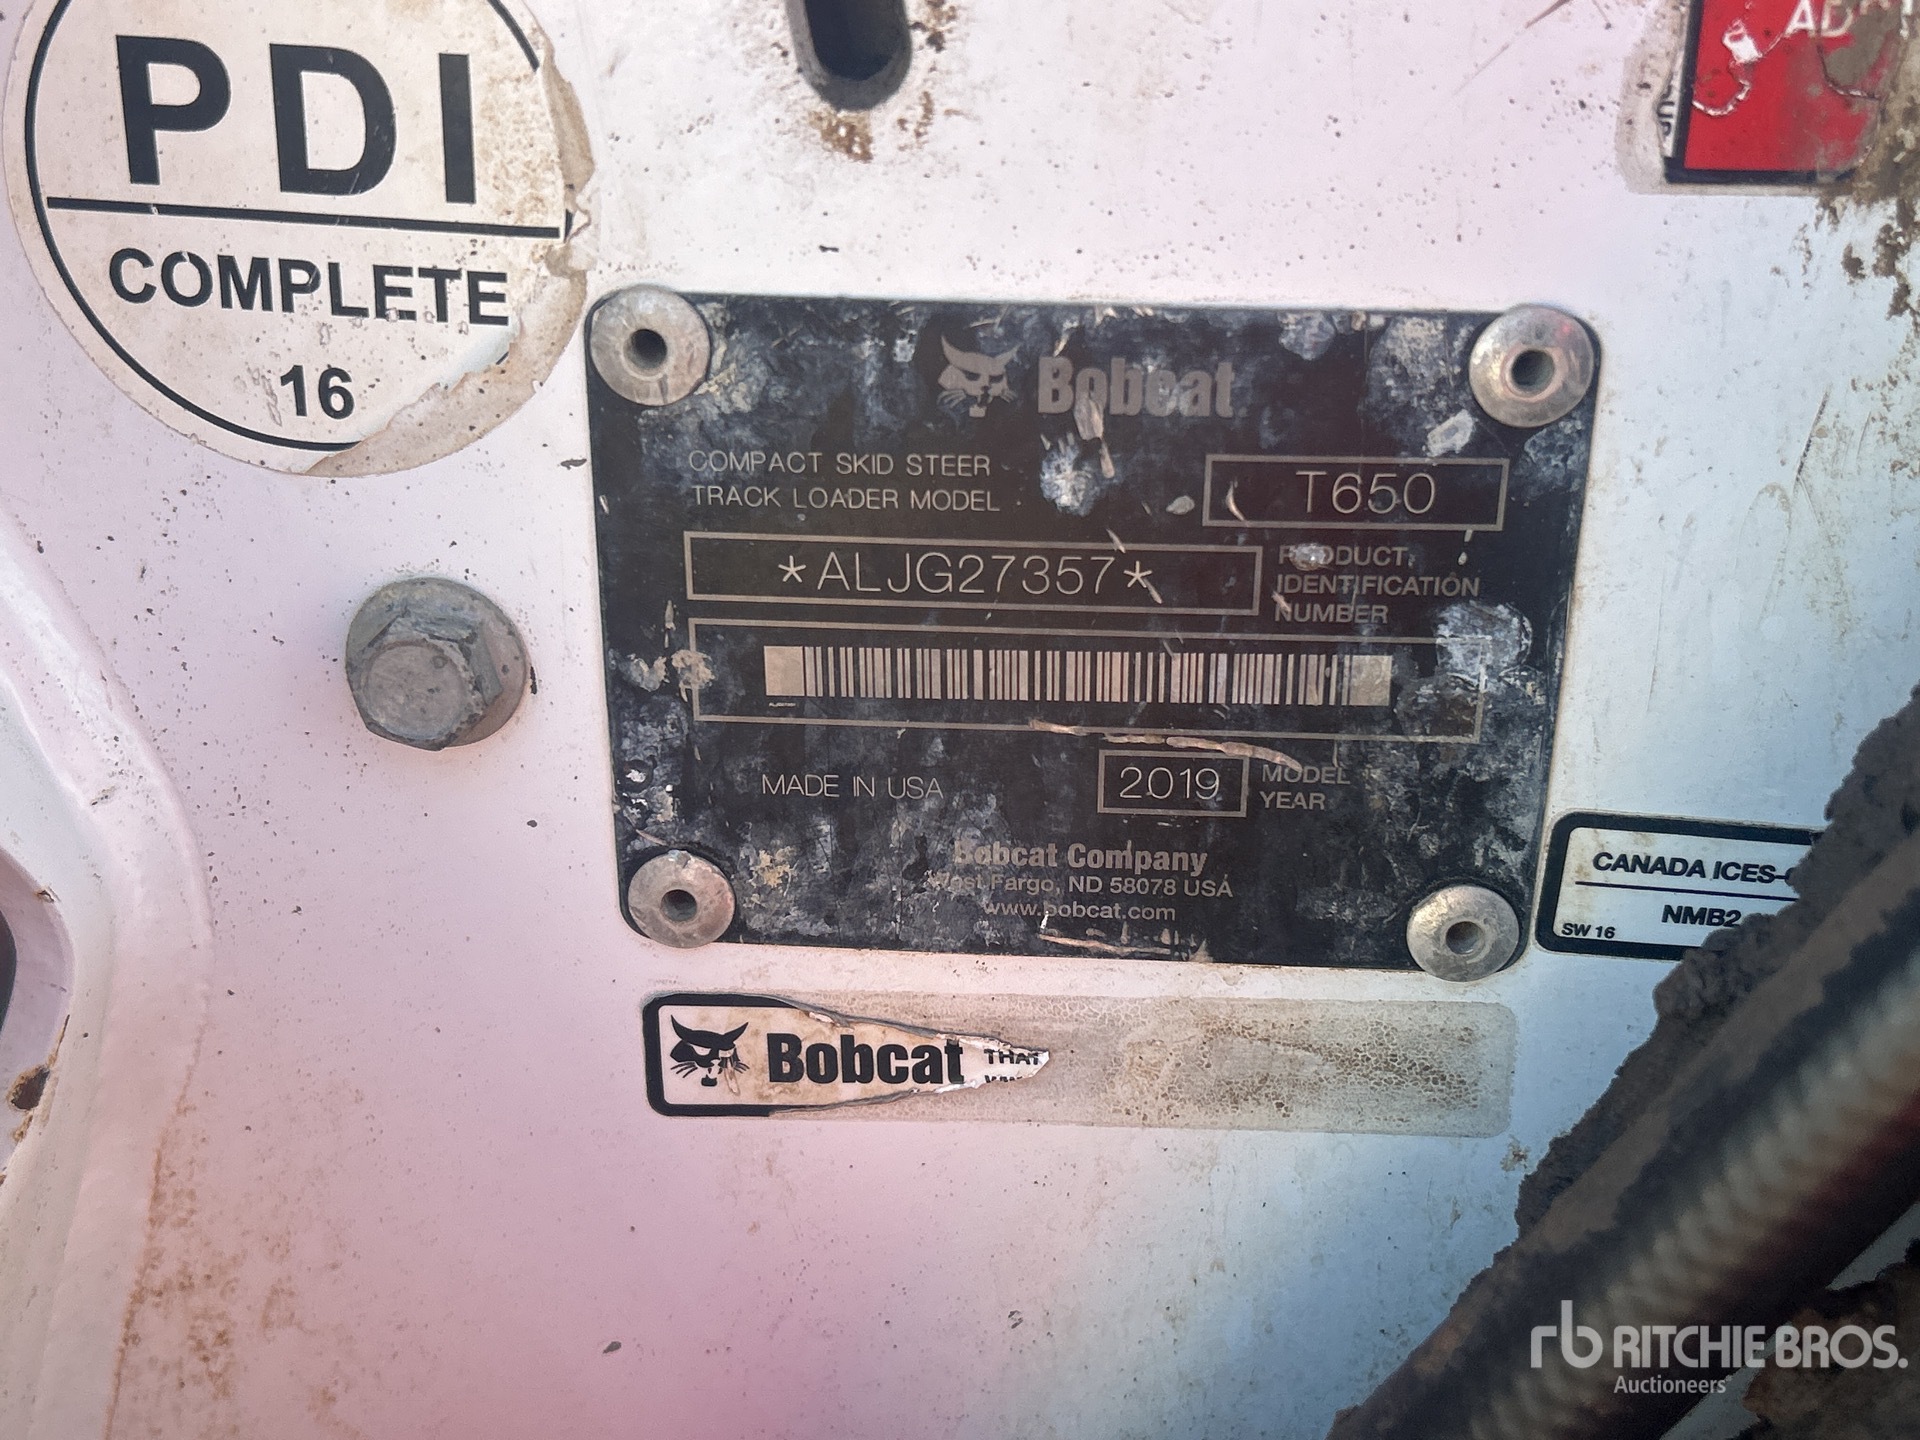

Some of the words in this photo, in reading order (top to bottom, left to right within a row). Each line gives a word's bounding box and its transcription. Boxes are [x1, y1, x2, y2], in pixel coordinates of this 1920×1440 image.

[116, 34, 476, 204] PDI
[108, 246, 510, 326] COMPLETE
[279, 364, 356, 420] 16
[1037, 355, 1236, 418] Bobcat
[688, 449, 823, 474] COMPACT
[836, 453, 894, 476] SKID
[906, 454, 991, 478] STEER
[691, 484, 782, 508] TRACK
[792, 487, 899, 510] LOADER
[911, 489, 1000, 513] MODEL
[1295, 470, 1436, 514] T650
[1278, 545, 1408, 568] PODUCT
[1276, 573, 1480, 597] IDENTIFICATION
[1274, 602, 1389, 624] NUMBER
[762, 773, 840, 798] MADE
[852, 775, 876, 798] IN
[887, 776, 944, 800] USA
[1118, 766, 1221, 801] 2019
[1262, 764, 1351, 785] MODEL
[1259, 790, 1326, 810] YEAR
[1067, 842, 1208, 877] Company
[1592, 851, 1706, 880] CANADA
[990, 874, 1061, 896] Fargo,
[1068, 876, 1103, 893] ND
[1109, 878, 1177, 895] 58078
[1183, 879, 1233, 898] USA
[982, 900, 1176, 921] www.bobcat.com
[1561, 922, 1591, 937] SW
[1595, 925, 1616, 939] 16
[766, 1032, 965, 1085] Bobcat
